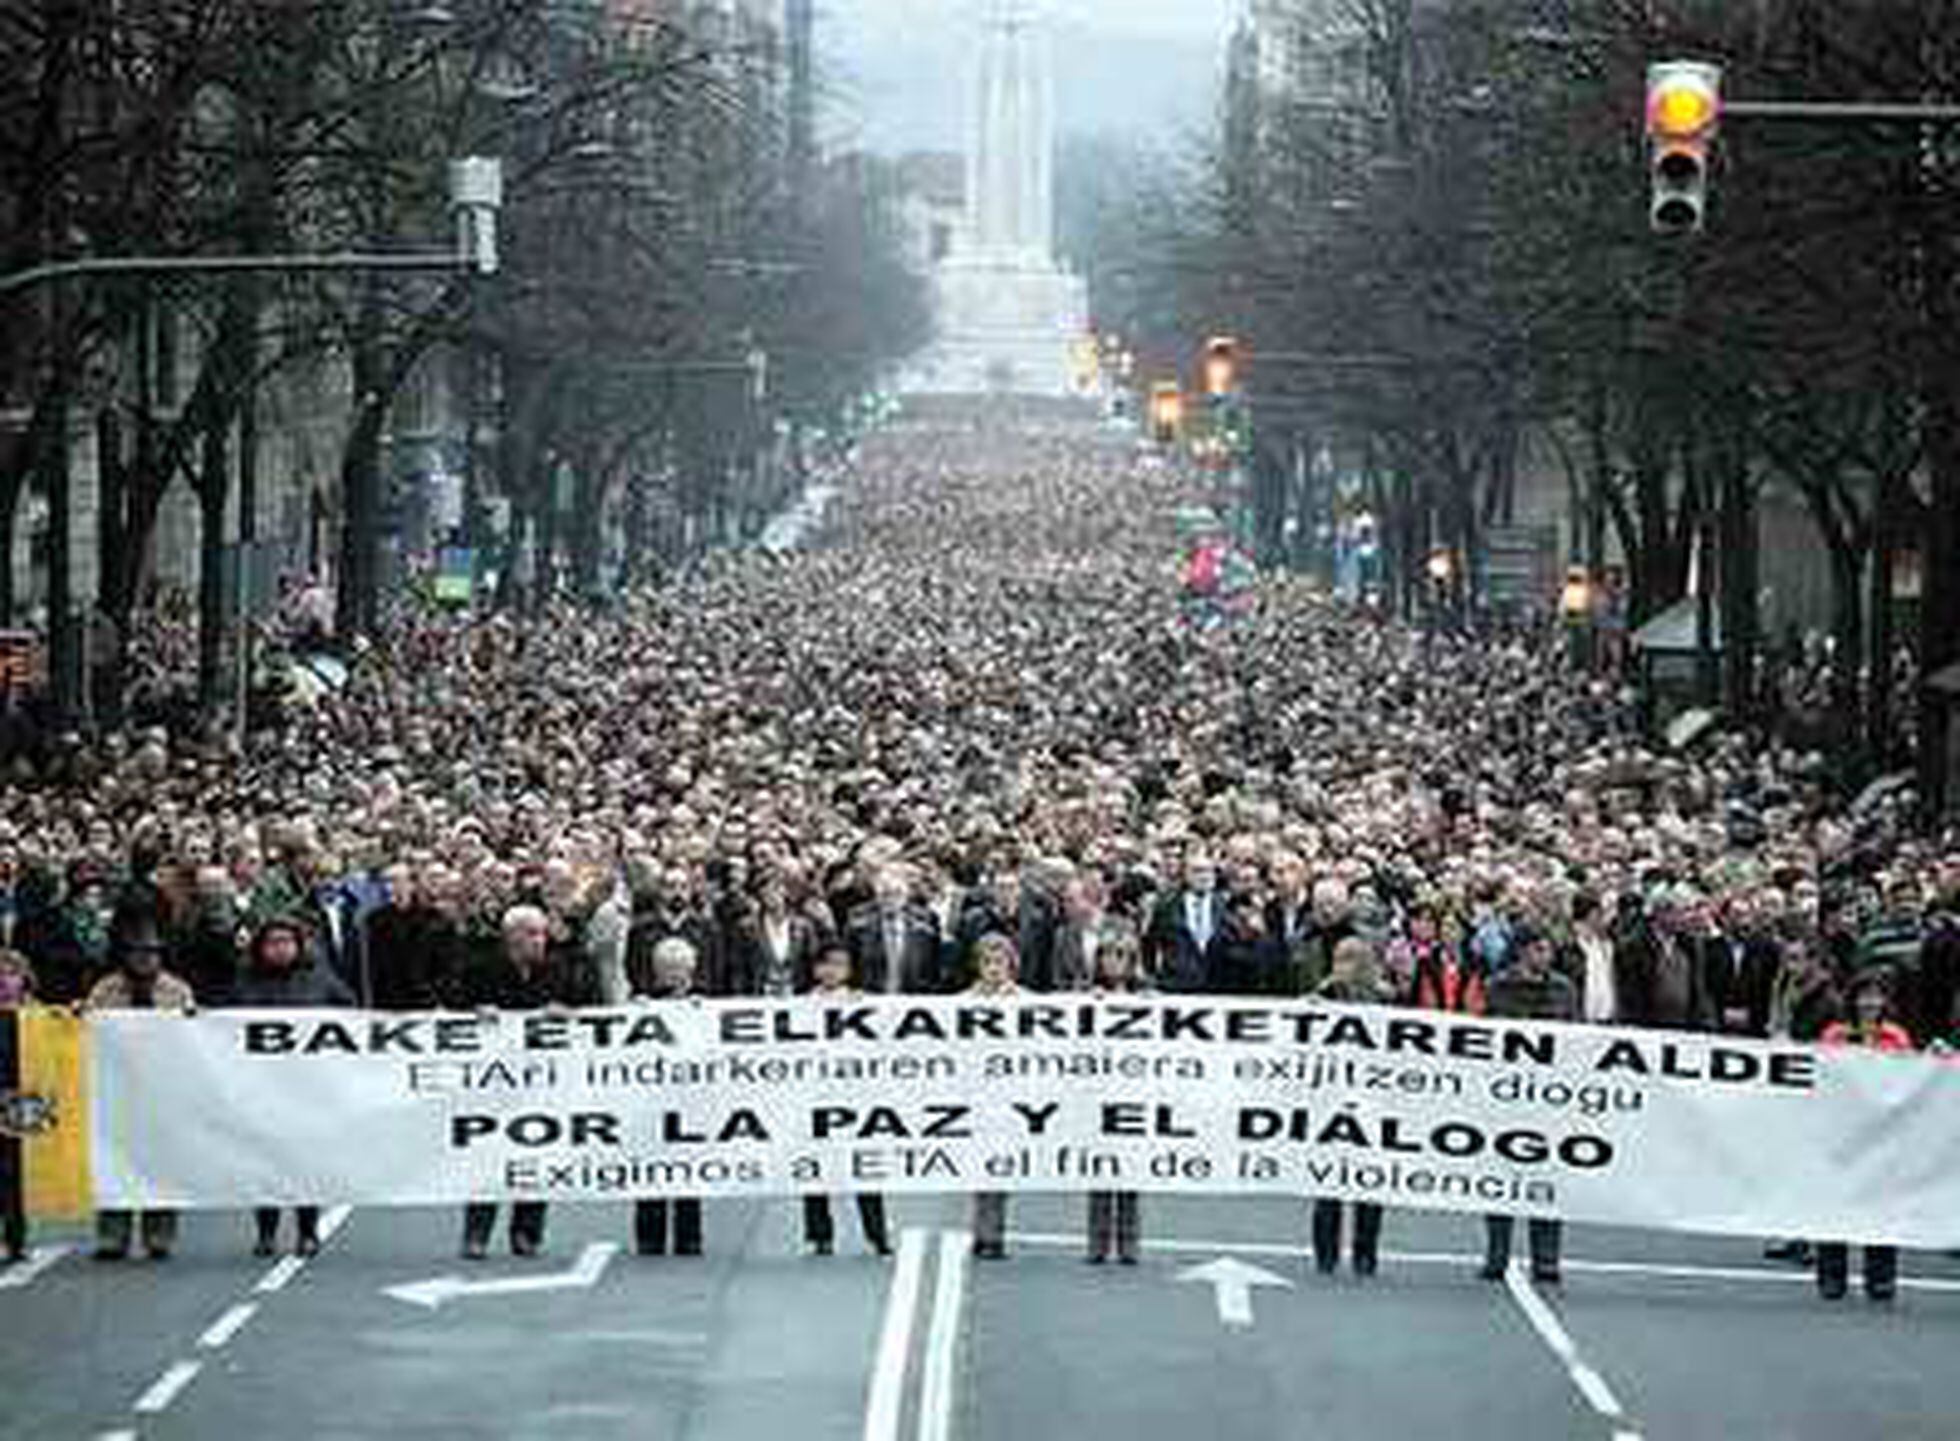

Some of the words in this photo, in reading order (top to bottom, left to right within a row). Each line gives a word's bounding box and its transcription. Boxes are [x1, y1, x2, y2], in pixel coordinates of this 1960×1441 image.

[243, 1017, 481, 1055] BAKE
[523, 1014, 676, 1050] ETA
[720, 1003, 1556, 1064] ELKARRIZKETAREN
[1596, 1040, 1816, 1088] ALDE
[985, 1053, 1203, 1080] amaiera
[1490, 1069, 1645, 1115] diogu
[451, 1114, 620, 1147] POR
[664, 1109, 771, 1144] LA
[812, 1106, 972, 1139] PAZ
[1012, 1103, 1060, 1134] Y
[1102, 1104, 1197, 1138] EL
[1237, 1102, 1614, 1169] DIÁLOGO
[505, 1159, 763, 1190] Exigimos
[791, 1156, 821, 1180] a
[986, 1147, 1030, 1178] el
[1058, 1147, 1120, 1177] fin
[1150, 1148, 1213, 1180] de
[1238, 1154, 1280, 1180] la
[1307, 1156, 1556, 1203] violencia
